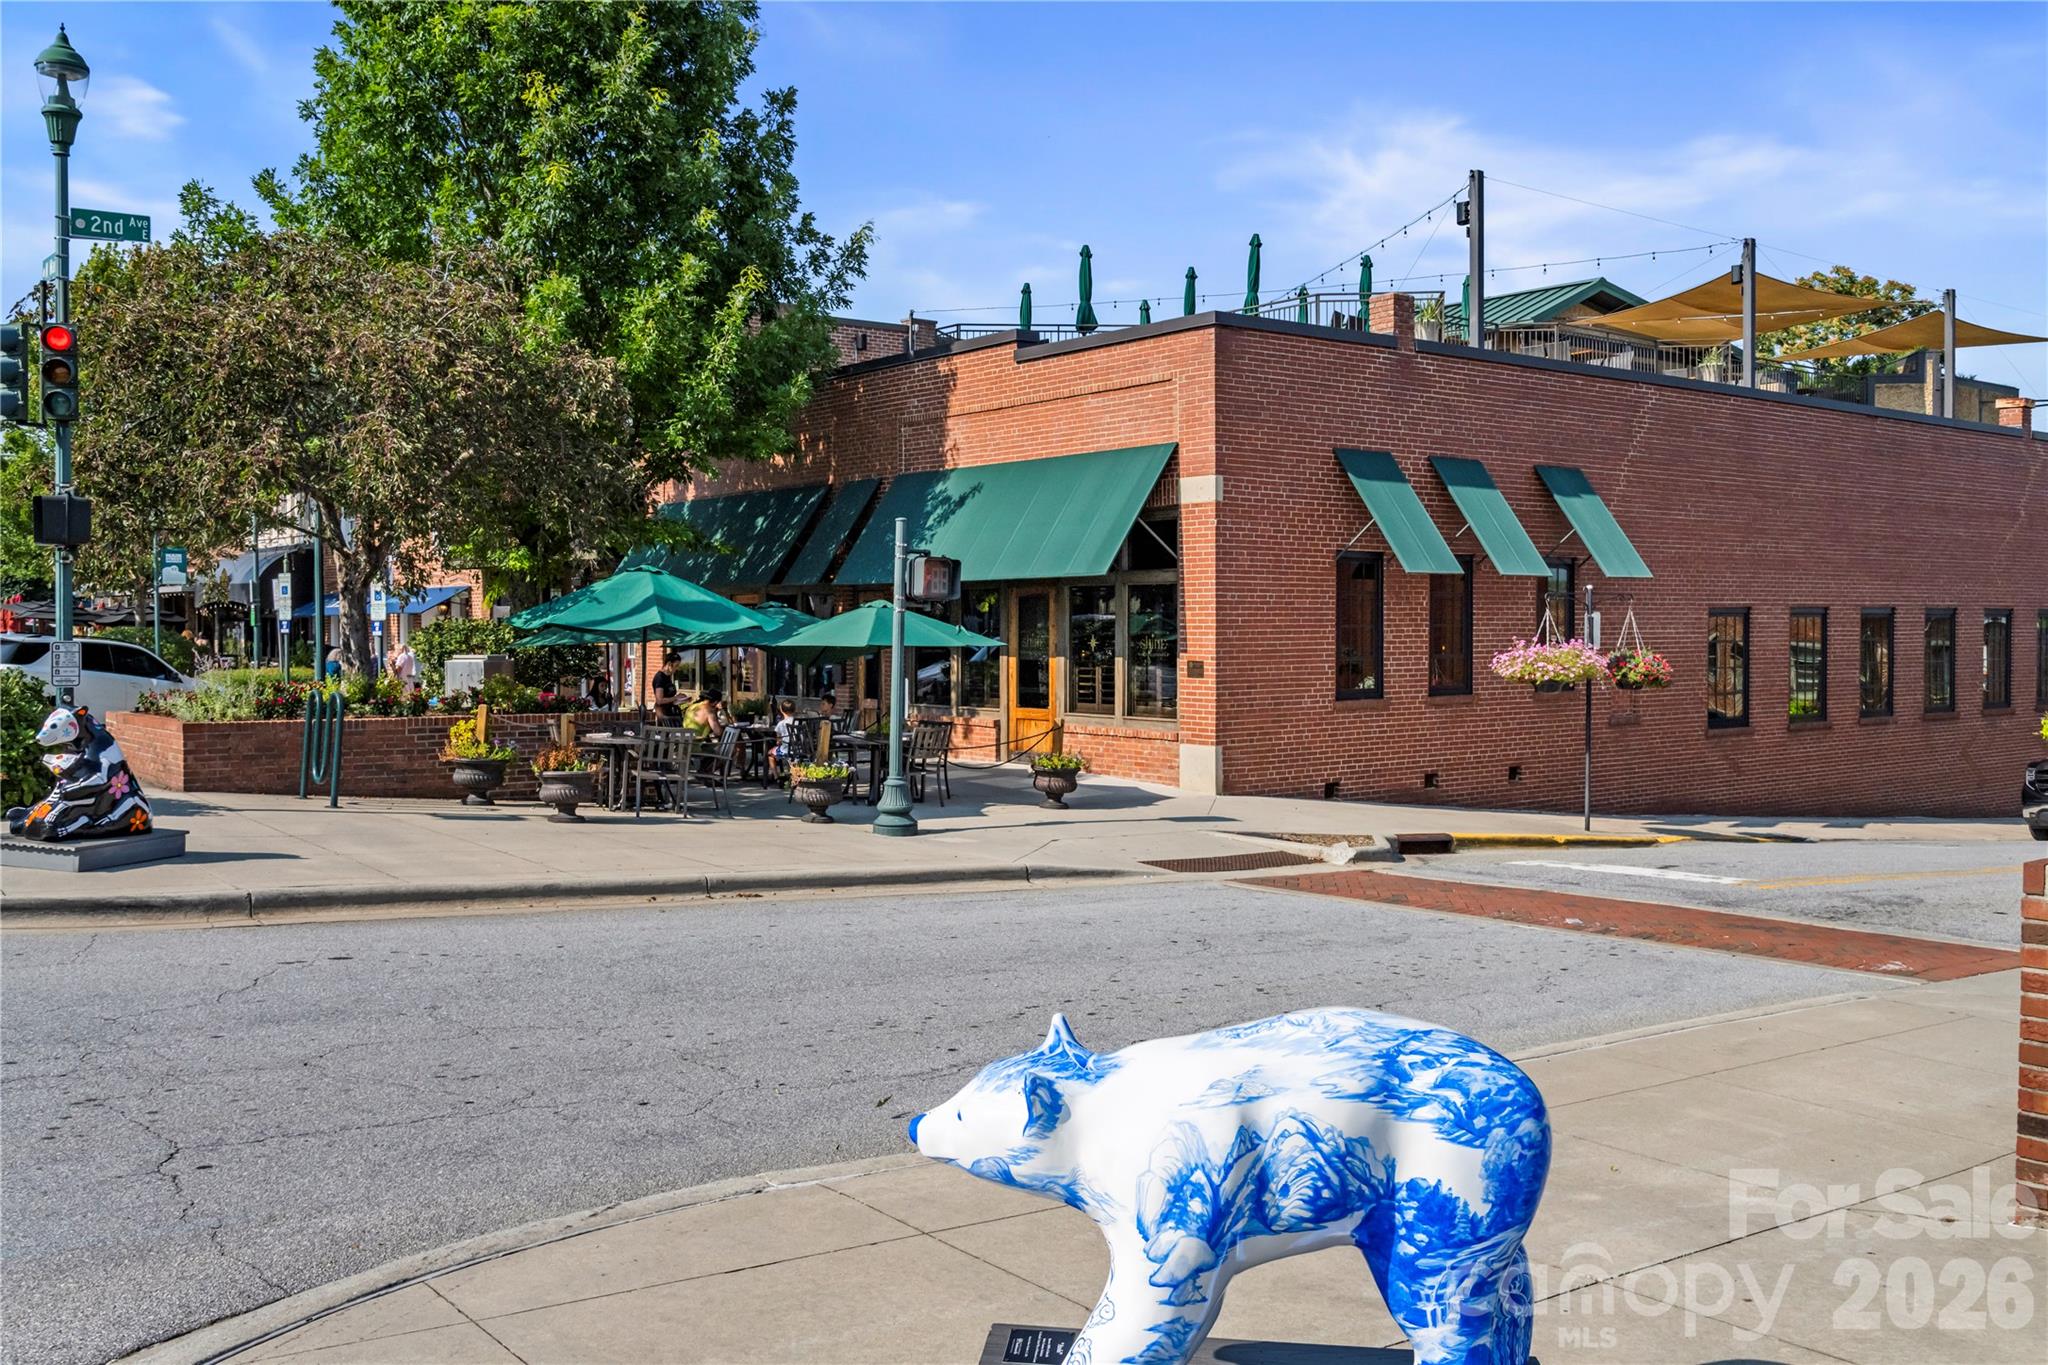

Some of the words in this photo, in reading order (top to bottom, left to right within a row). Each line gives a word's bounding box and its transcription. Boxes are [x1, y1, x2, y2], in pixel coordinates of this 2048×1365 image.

[90, 215, 124, 235] 2nd
[129, 216, 149, 229] Ave
[142, 229, 149, 240] E
